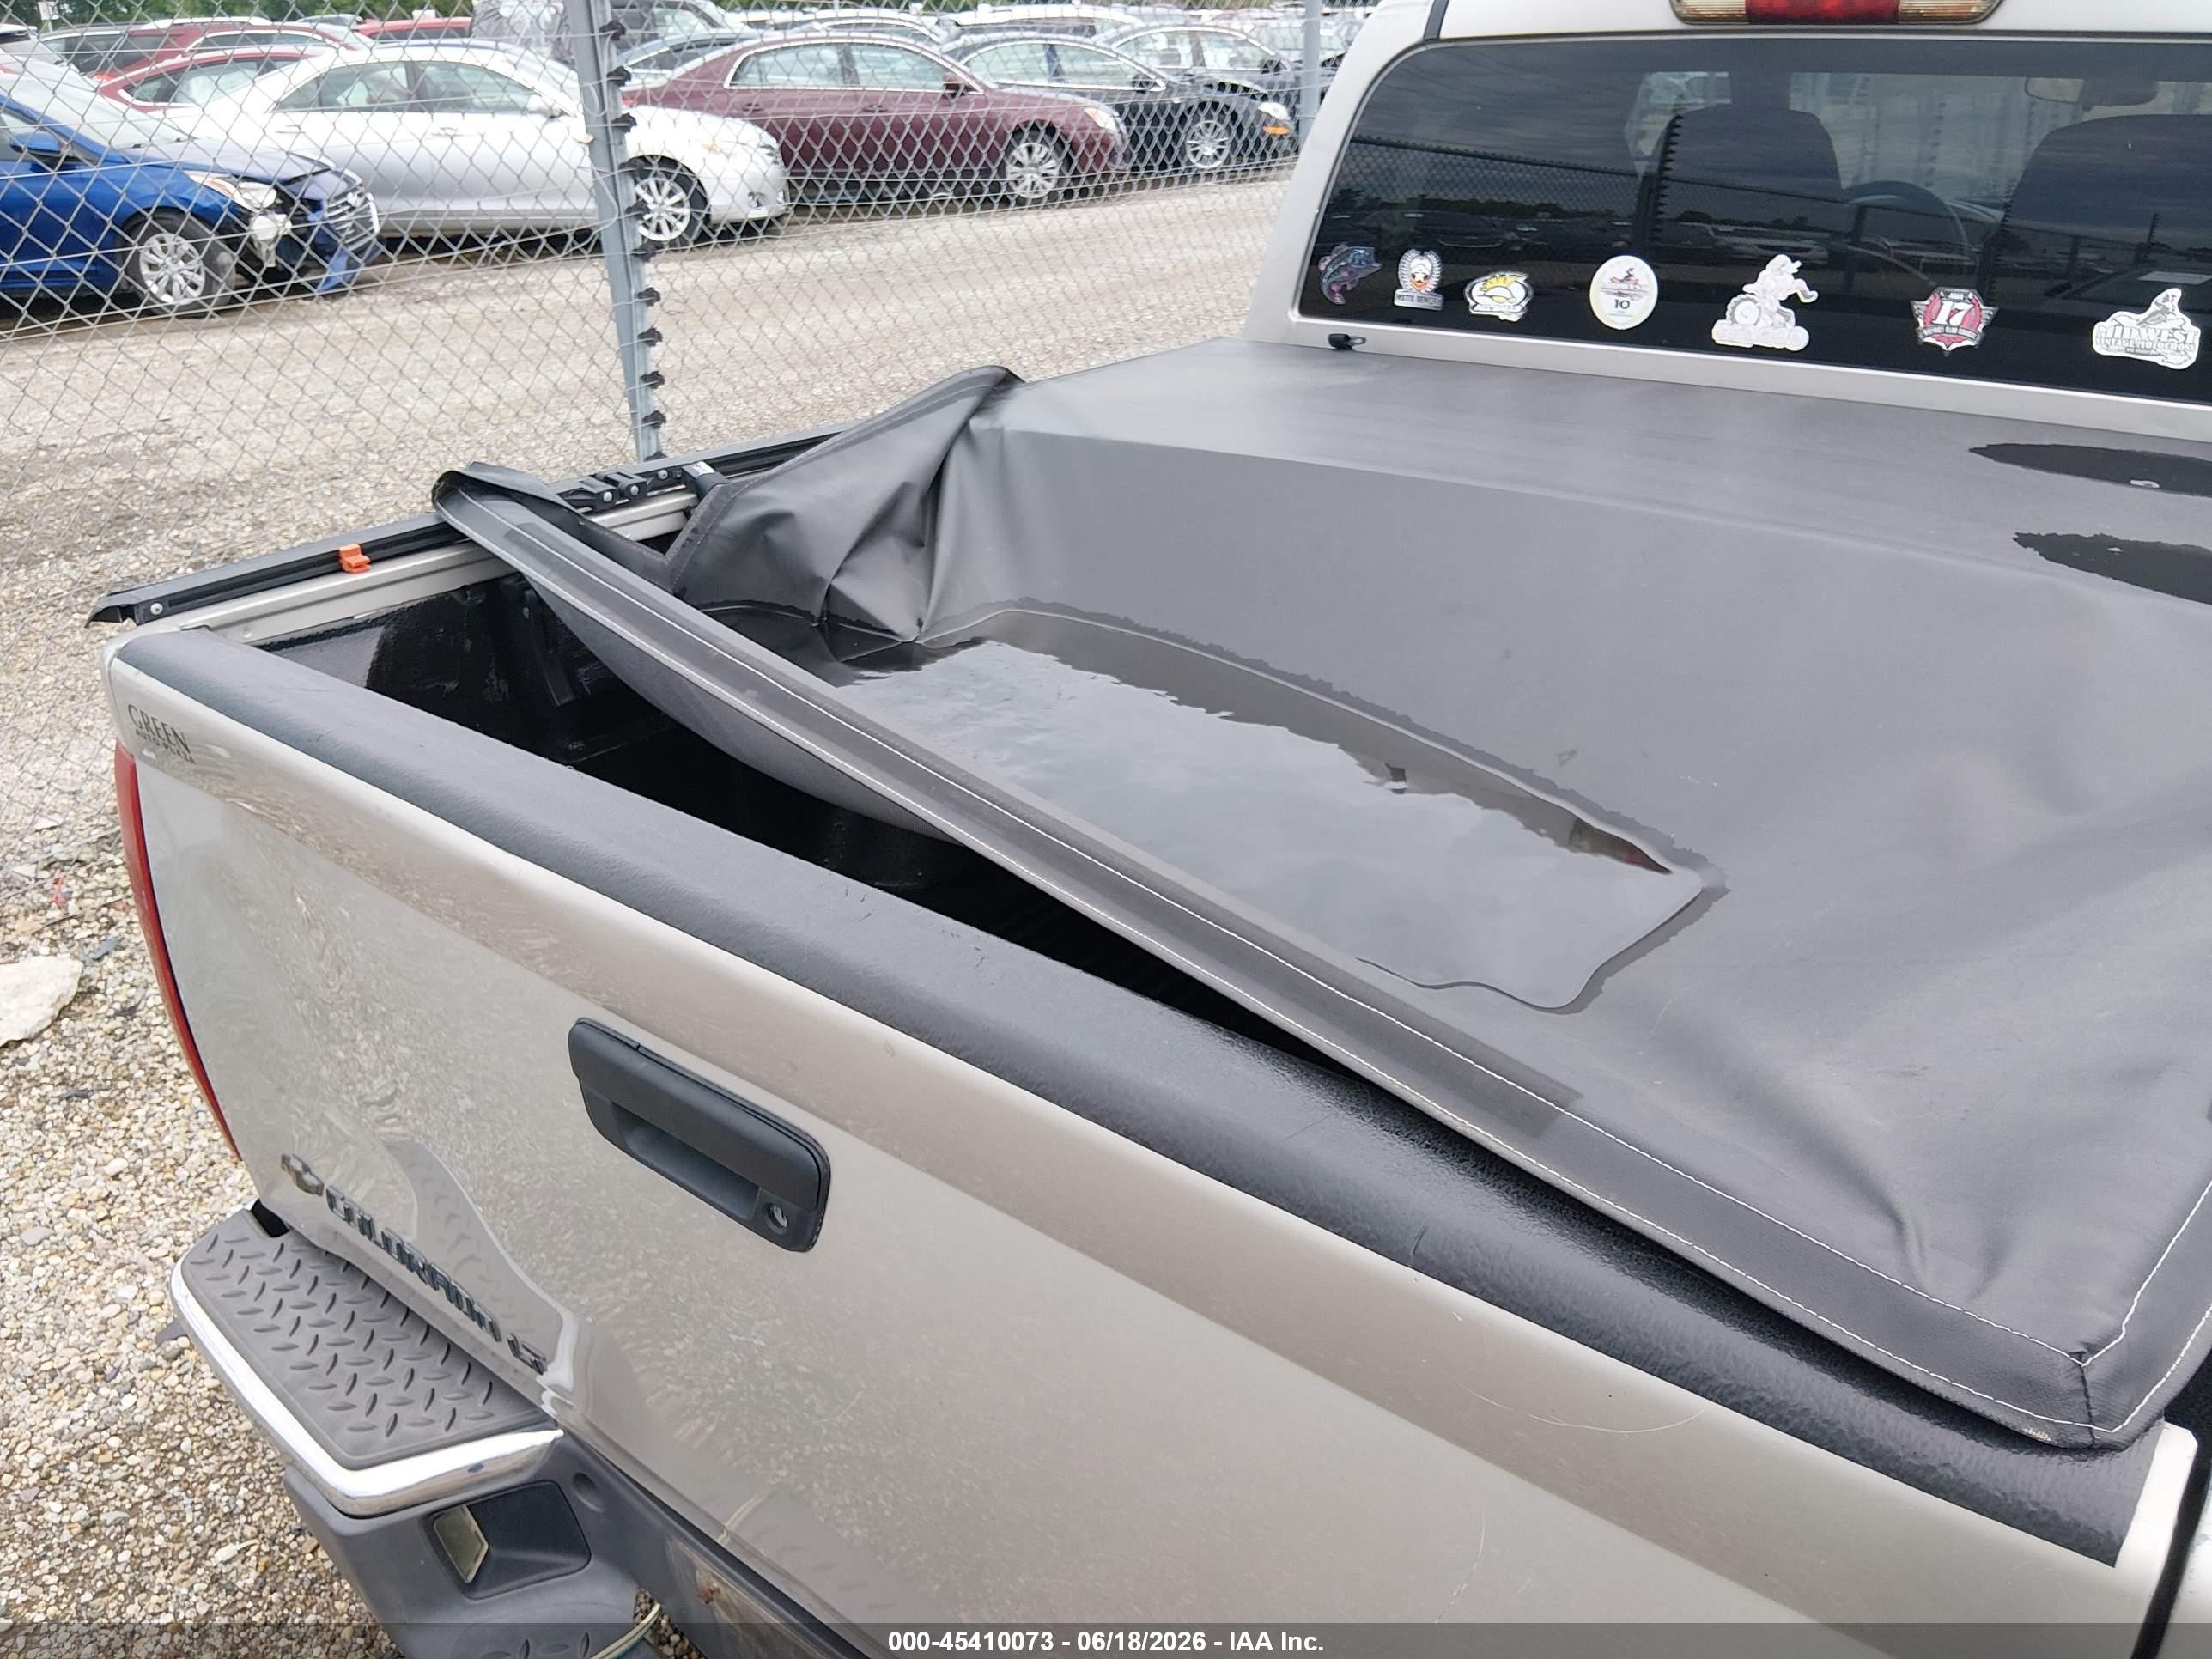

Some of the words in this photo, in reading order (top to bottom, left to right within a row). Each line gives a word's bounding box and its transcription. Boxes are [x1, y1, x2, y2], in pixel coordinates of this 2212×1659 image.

[1614, 299, 1630, 309] 10
[1932, 301, 1974, 326] 17
[2096, 325, 2197, 345] MIDWEST
[127, 704, 191, 754] GREEN
